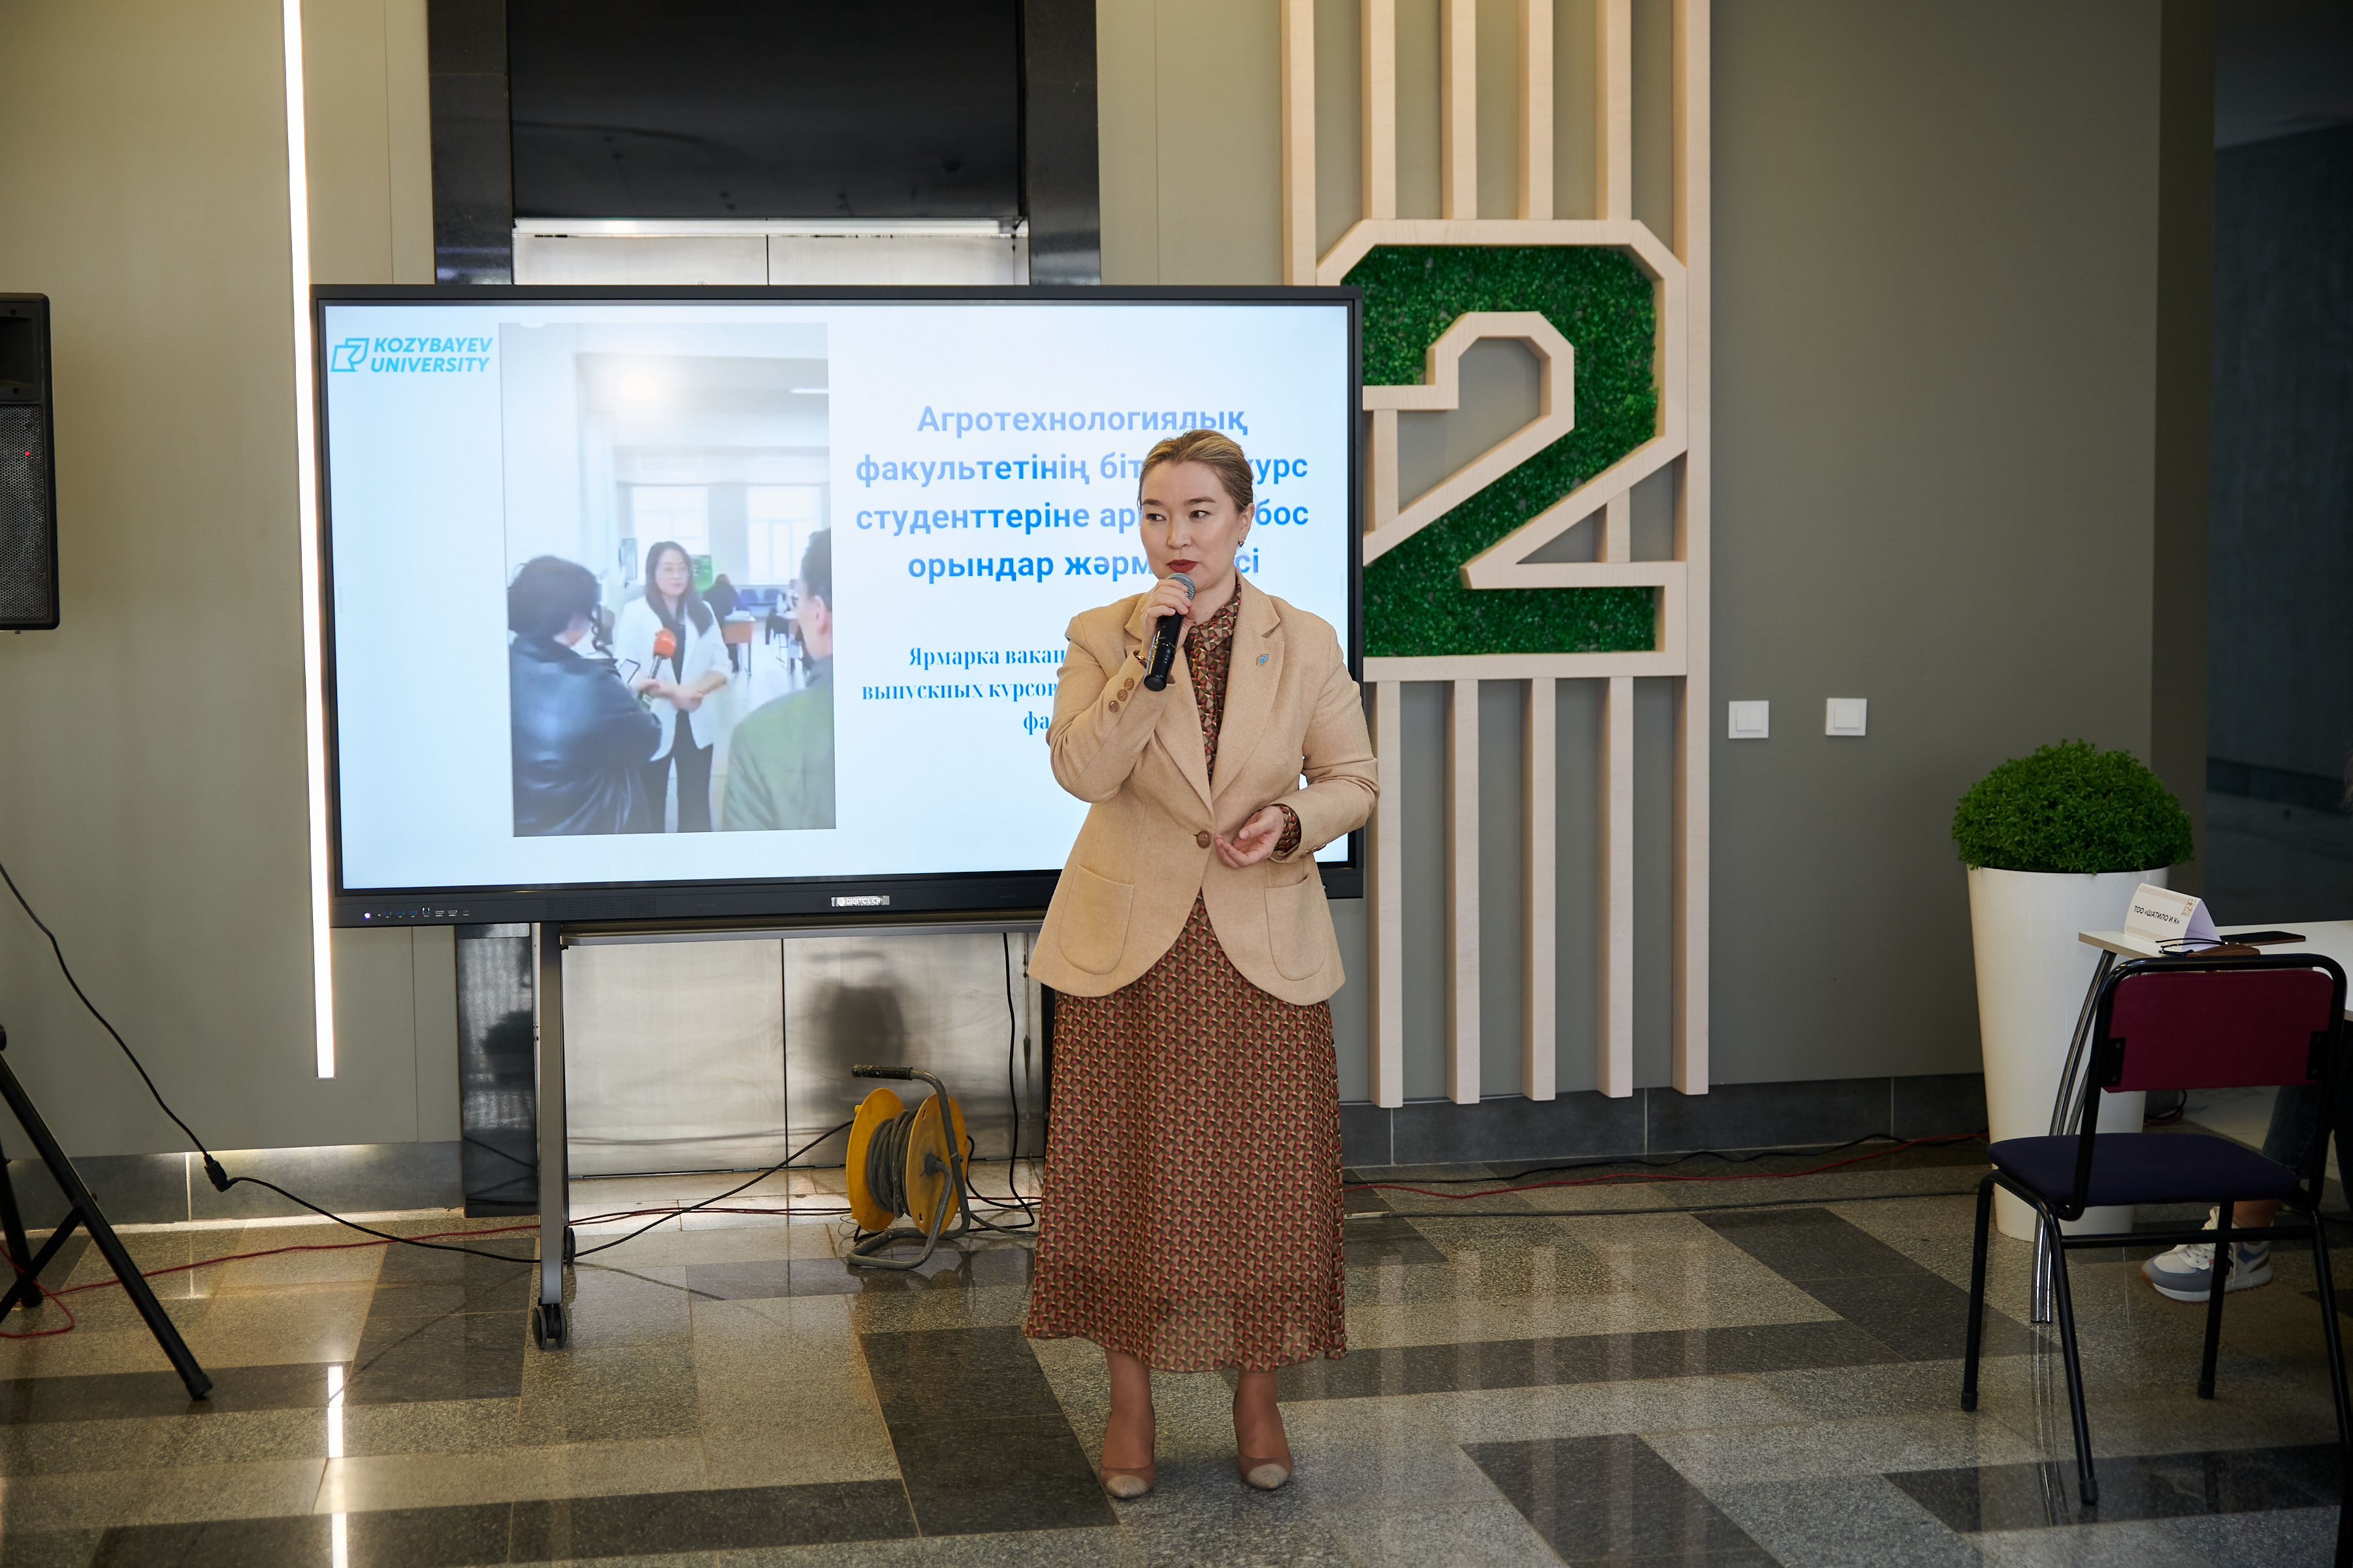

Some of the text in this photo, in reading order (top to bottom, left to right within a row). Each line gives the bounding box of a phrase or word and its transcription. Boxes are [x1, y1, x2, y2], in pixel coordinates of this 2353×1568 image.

[373, 337, 494, 353] KOZYBAYEV
[370, 357, 491, 373] UNIVERSITY
[917, 405, 1248, 439] Агротехнологиялық
[856, 453, 1090, 488] факультетінің
[1248, 458, 1308, 485] урс
[856, 502, 1090, 536] студенттеріне
[1255, 498, 1309, 526] бос
[908, 556, 1054, 584] орындар
[909, 647, 1065, 671] Ярмарка вакан
[862, 684, 983, 705] выпускных
[2134, 905, 2145, 914] ТОО
[2145, 909, 2169, 921] «ШАТИЛО
